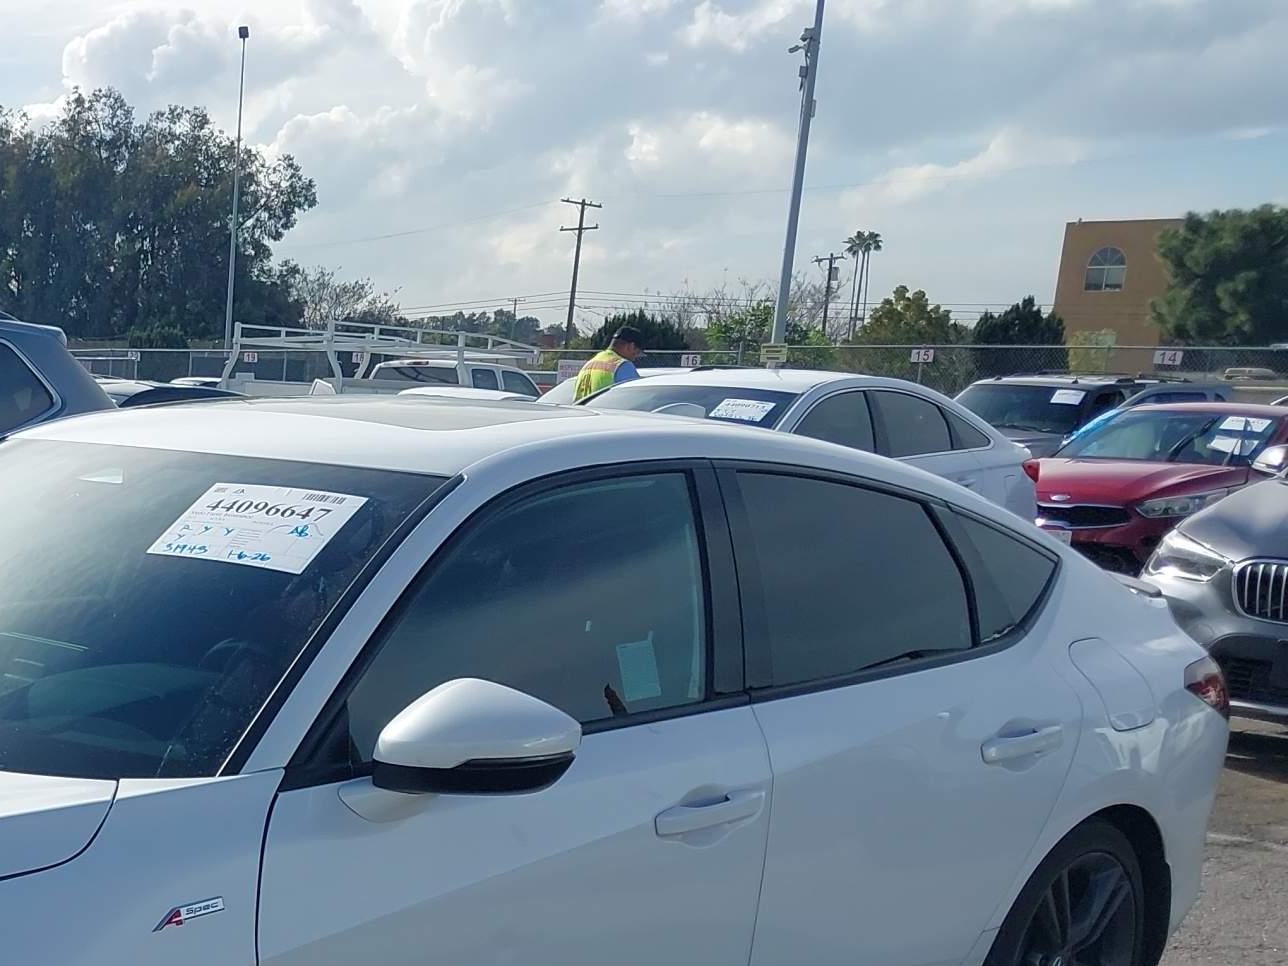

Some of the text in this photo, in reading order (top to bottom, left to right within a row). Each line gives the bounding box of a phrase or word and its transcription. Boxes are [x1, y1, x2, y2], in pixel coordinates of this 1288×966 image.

[685, 355, 698, 365] 16
[916, 351, 930, 361] 15
[1159, 352, 1177, 364] 14
[206, 498, 333, 522] 44096647
